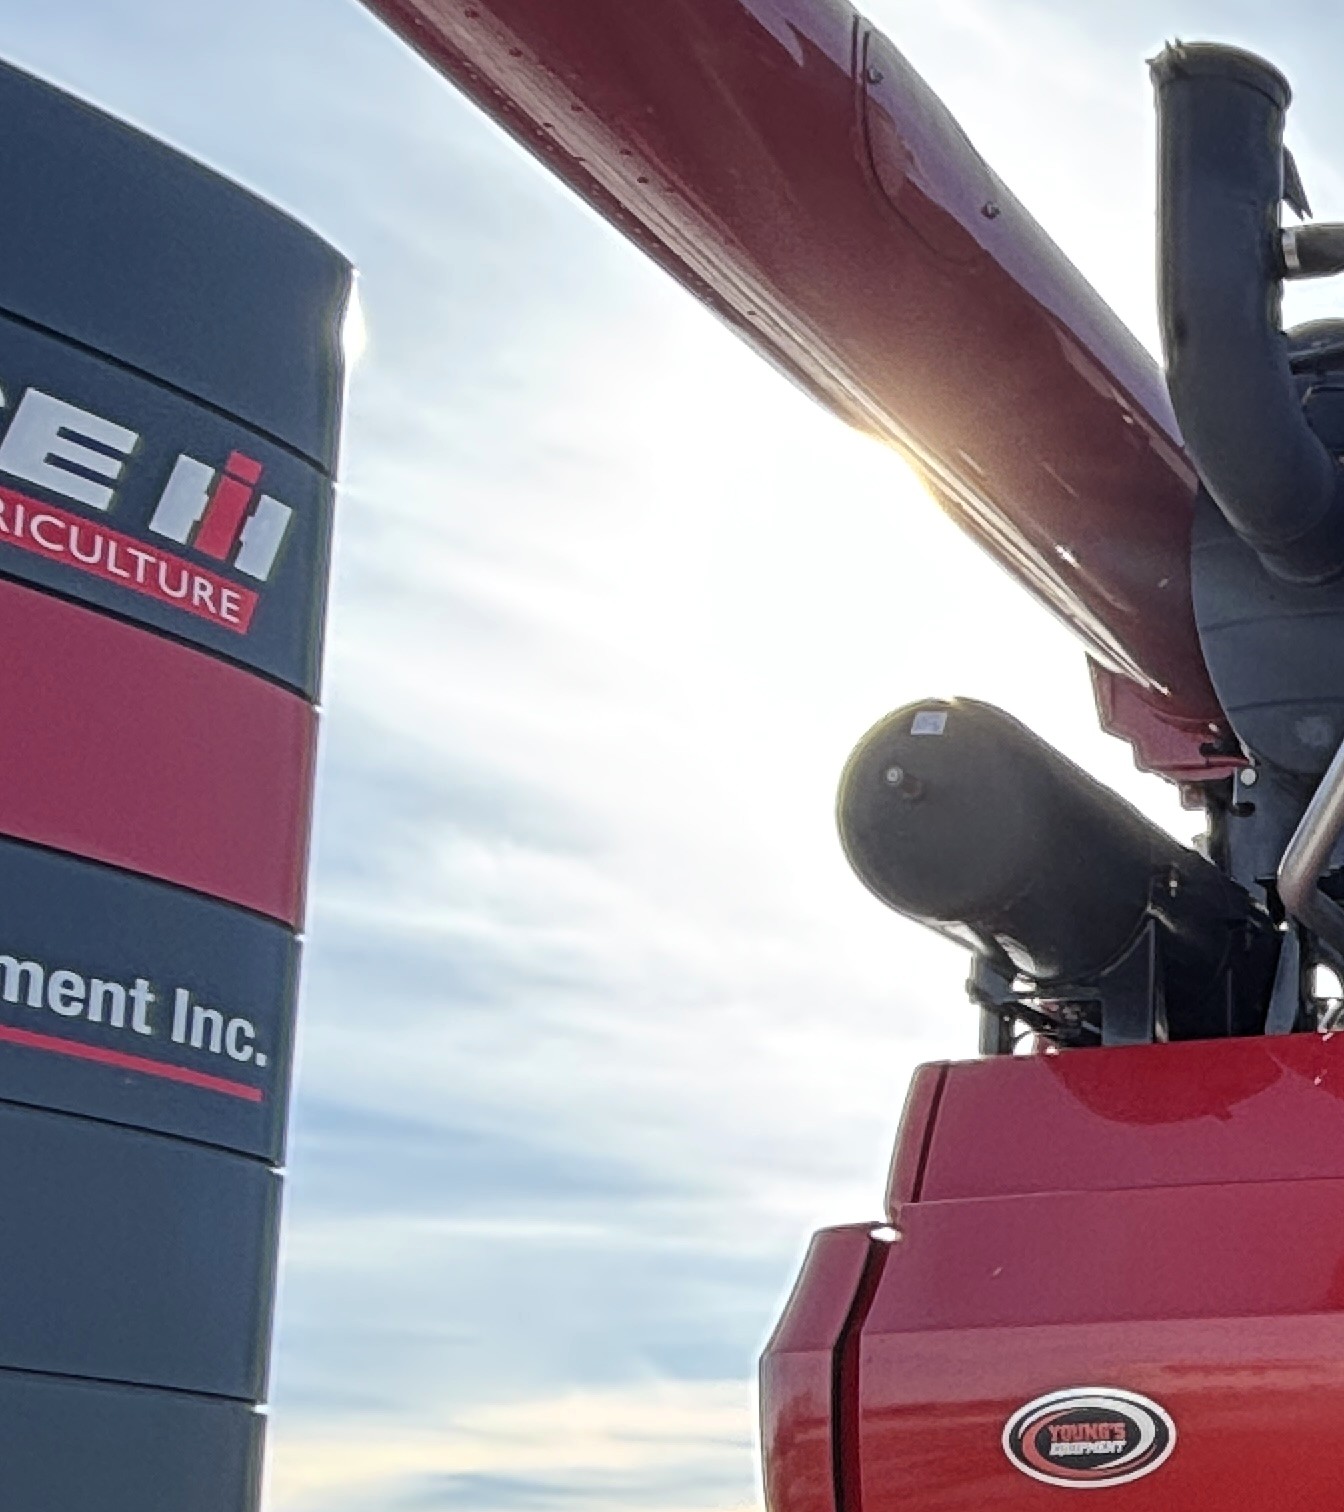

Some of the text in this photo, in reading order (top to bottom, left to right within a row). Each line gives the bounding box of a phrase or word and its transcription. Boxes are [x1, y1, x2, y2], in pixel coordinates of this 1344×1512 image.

[0, 385, 140, 511] E
[0, 954, 268, 1067] ment Inc.
